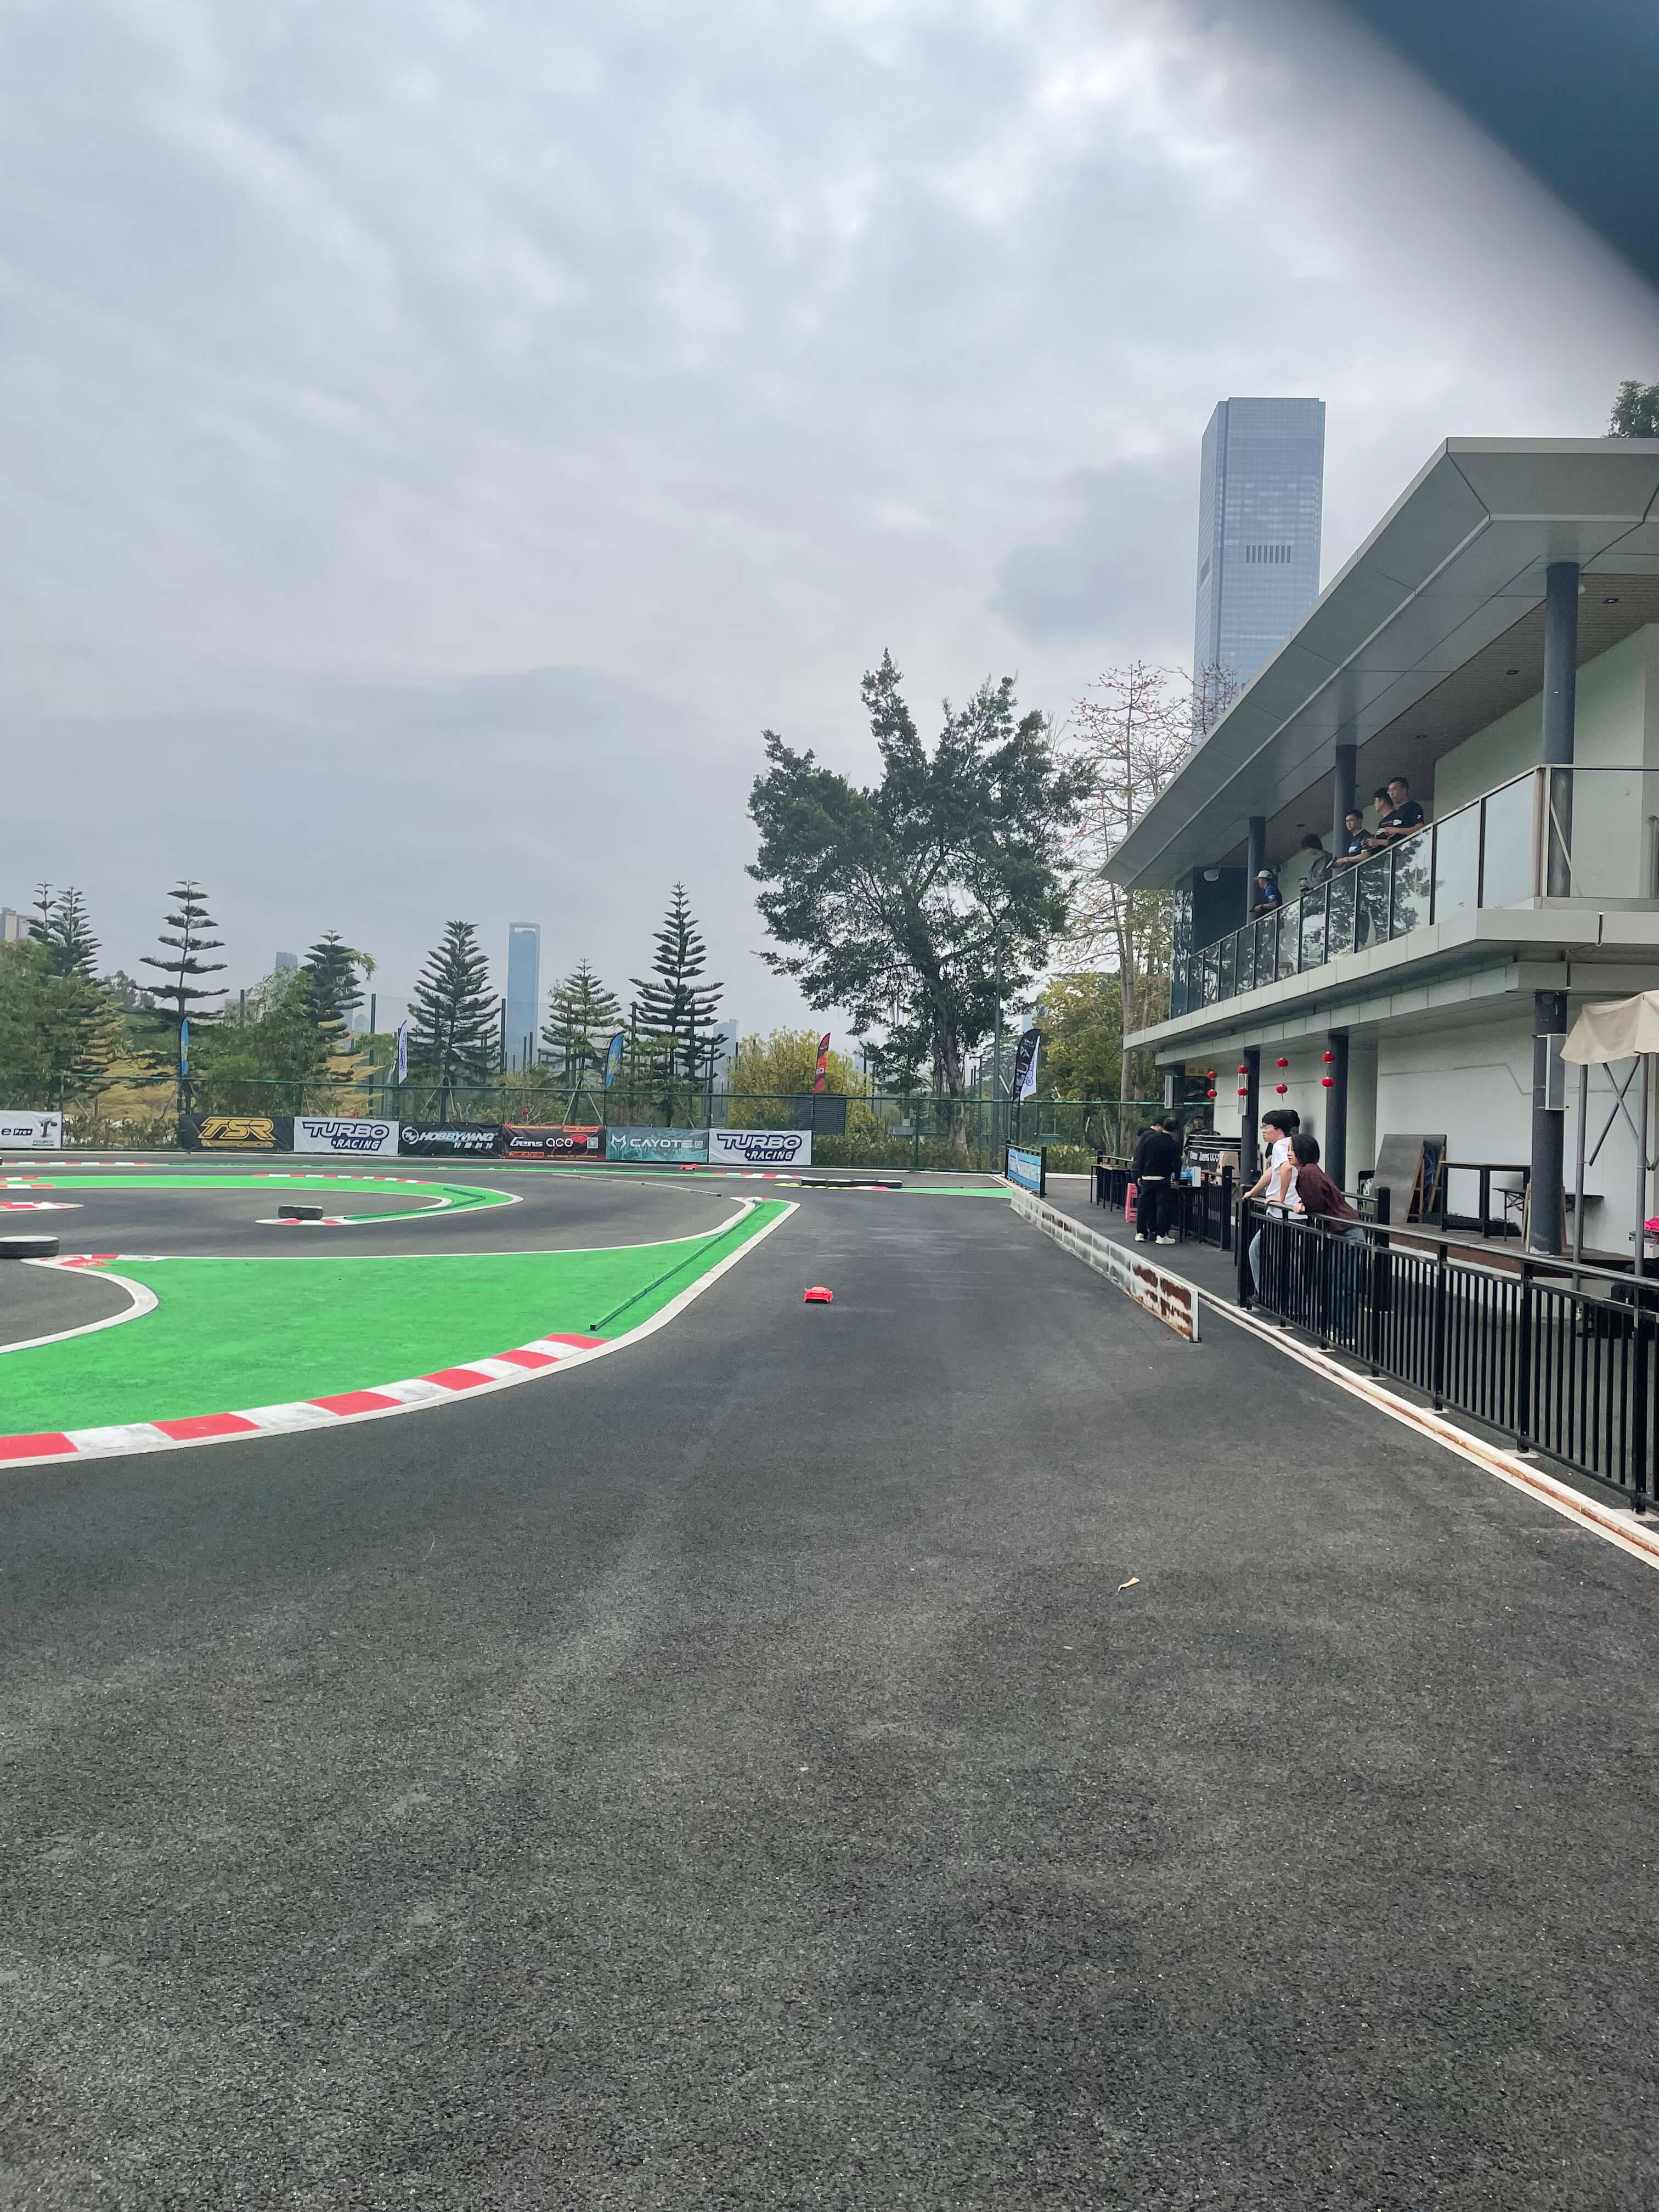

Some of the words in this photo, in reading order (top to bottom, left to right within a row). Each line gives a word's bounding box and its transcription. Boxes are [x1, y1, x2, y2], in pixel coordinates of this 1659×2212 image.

[198, 1116, 276, 1140] TSR
[302, 1121, 390, 1139] TURBO
[419, 1132, 495, 1142] HOBBYWING
[510, 1137, 543, 1147] Gens
[546, 1137, 573, 1148] ace
[716, 1133, 802, 1150] TURBO
[336, 1139, 381, 1150] RACING
[630, 1138, 693, 1148] CAYOTE
[750, 1150, 794, 1161] RACING
